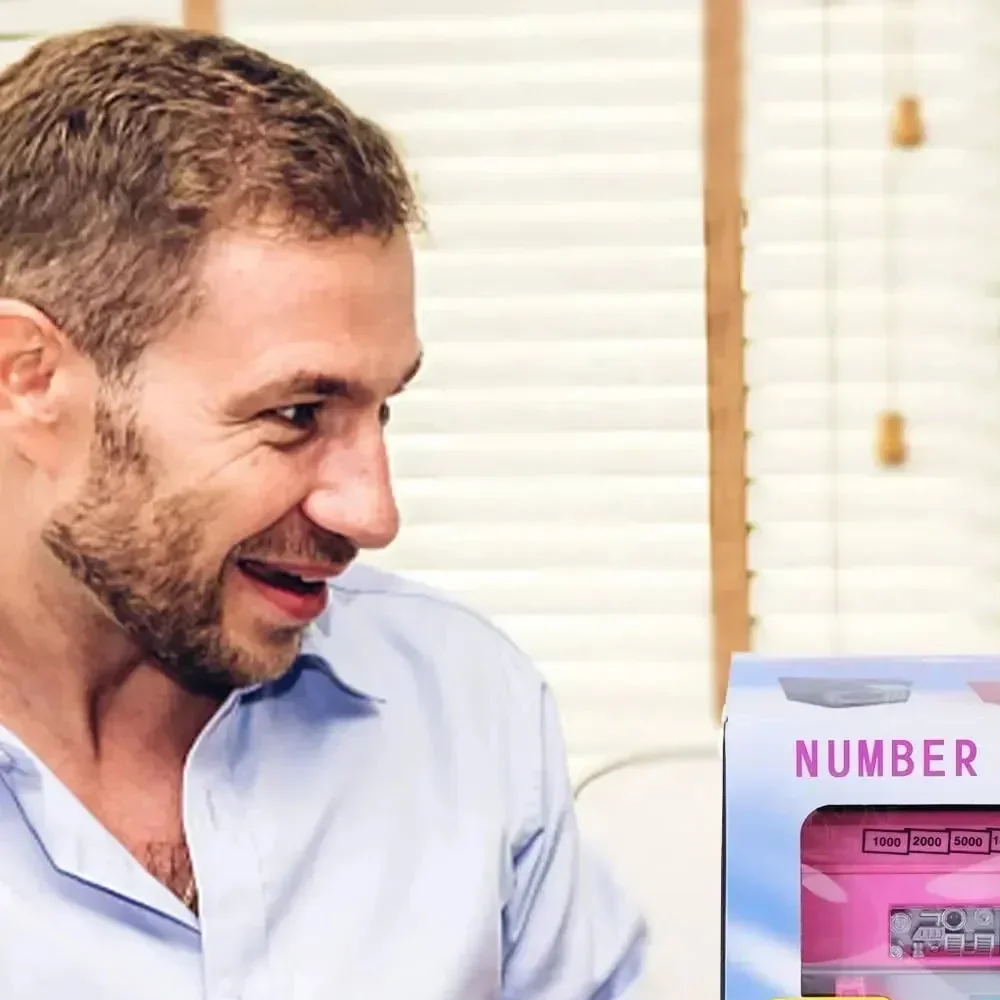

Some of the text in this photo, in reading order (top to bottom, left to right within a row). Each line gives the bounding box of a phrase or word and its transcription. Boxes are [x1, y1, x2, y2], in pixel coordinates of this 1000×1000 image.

[795, 739, 978, 778] NUMBER
[873, 836, 902, 848] 1000
[912, 836, 942, 847] 2000
[953, 836, 983, 847] 5000
